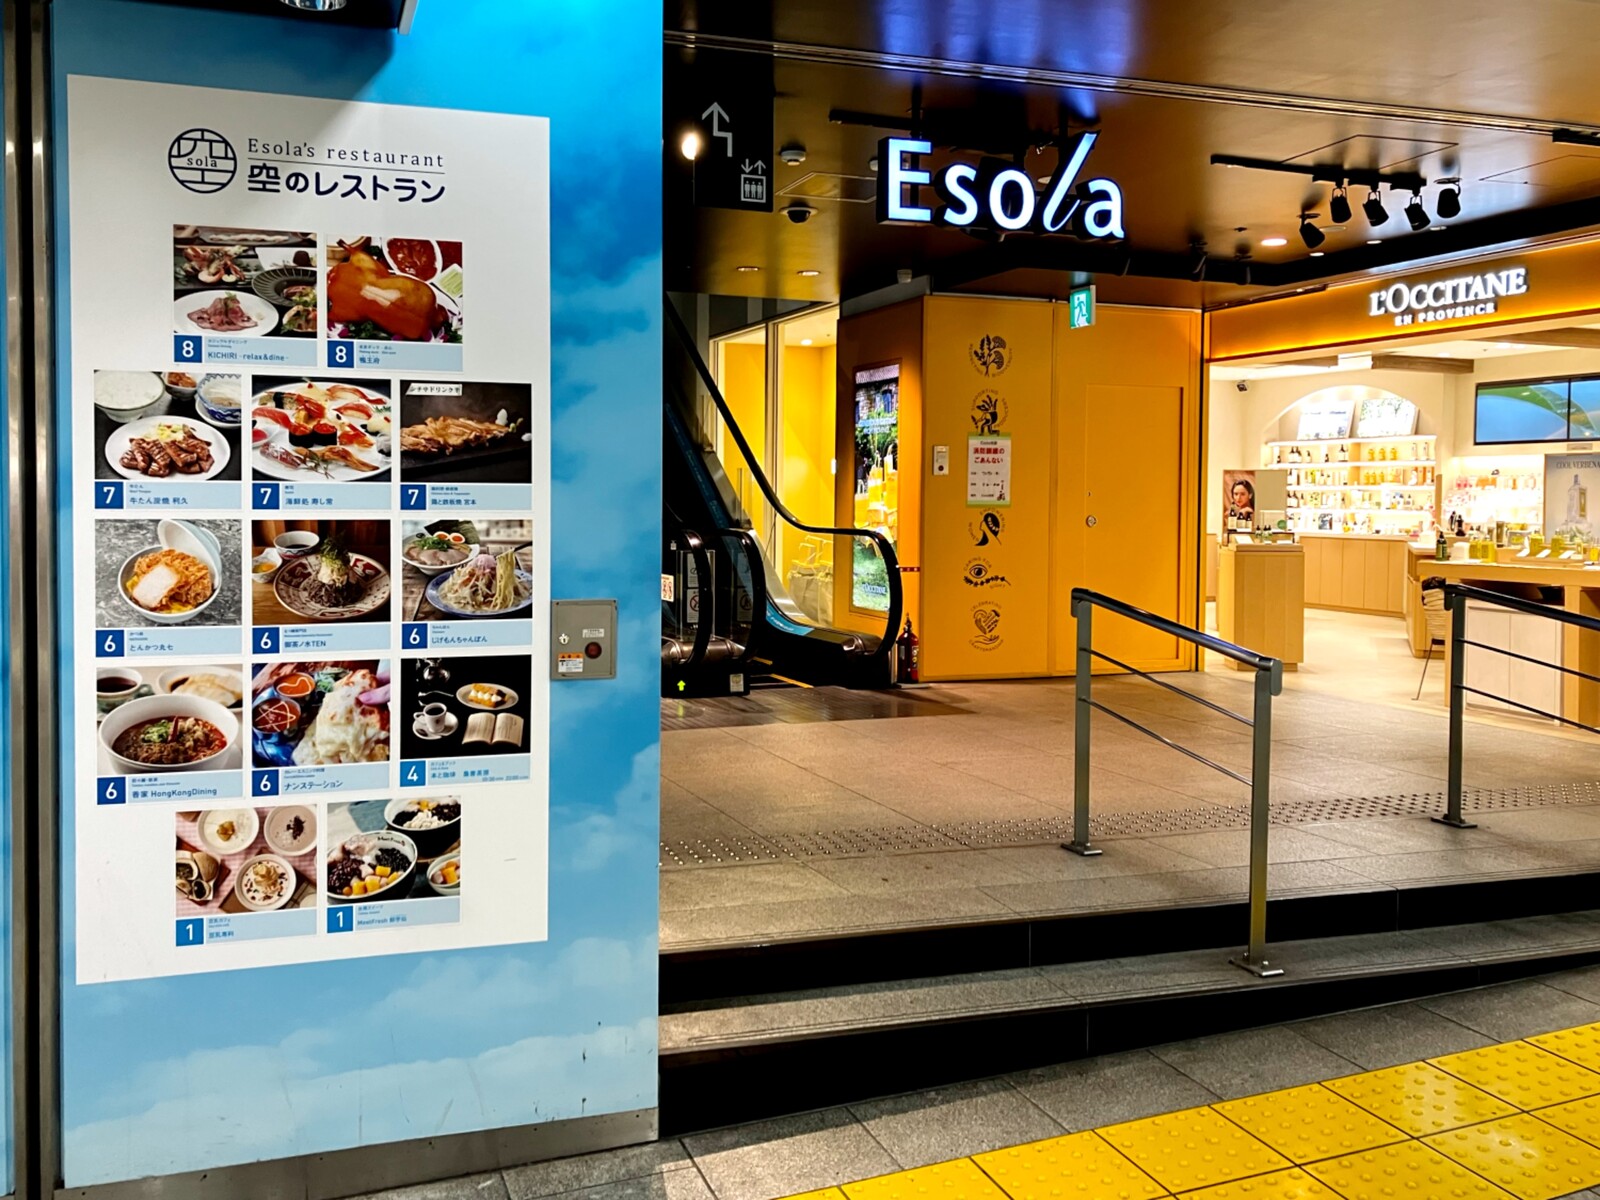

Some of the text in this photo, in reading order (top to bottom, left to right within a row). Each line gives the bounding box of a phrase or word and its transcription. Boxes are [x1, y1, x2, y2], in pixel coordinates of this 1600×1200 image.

[186, 156, 218, 168] sola
[247, 138, 444, 168] Esola's restaurant
[247, 163, 446, 203] 空のレストラン
[888, 132, 1125, 239] Esola
[1368, 268, 1528, 316] L'OCCITANE
[1394, 302, 1496, 326] EN PROVENCE
[182, 340, 195, 358] 8
[207, 351, 238, 360] KICHIRI
[335, 345, 347, 363] 8
[103, 486, 116, 505] 7
[260, 487, 272, 505] 7
[285, 497, 309, 506] 海鮮処
[408, 488, 419, 506] 7
[104, 634, 116, 652] 6
[260, 631, 272, 649] 6
[284, 640, 326, 648] 御茶ノ水TEN
[409, 627, 420, 645] 6
[431, 635, 488, 645] じげもんちゃんぽん
[129, 643, 174, 652] とんかつ丸七
[406, 765, 419, 782] 4
[105, 781, 117, 800] 6
[260, 774, 272, 792] 6
[284, 780, 343, 792] ナンステーション
[150, 787, 218, 800] HongKongDining
[336, 911, 344, 928] 1
[185, 923, 194, 941] 1
